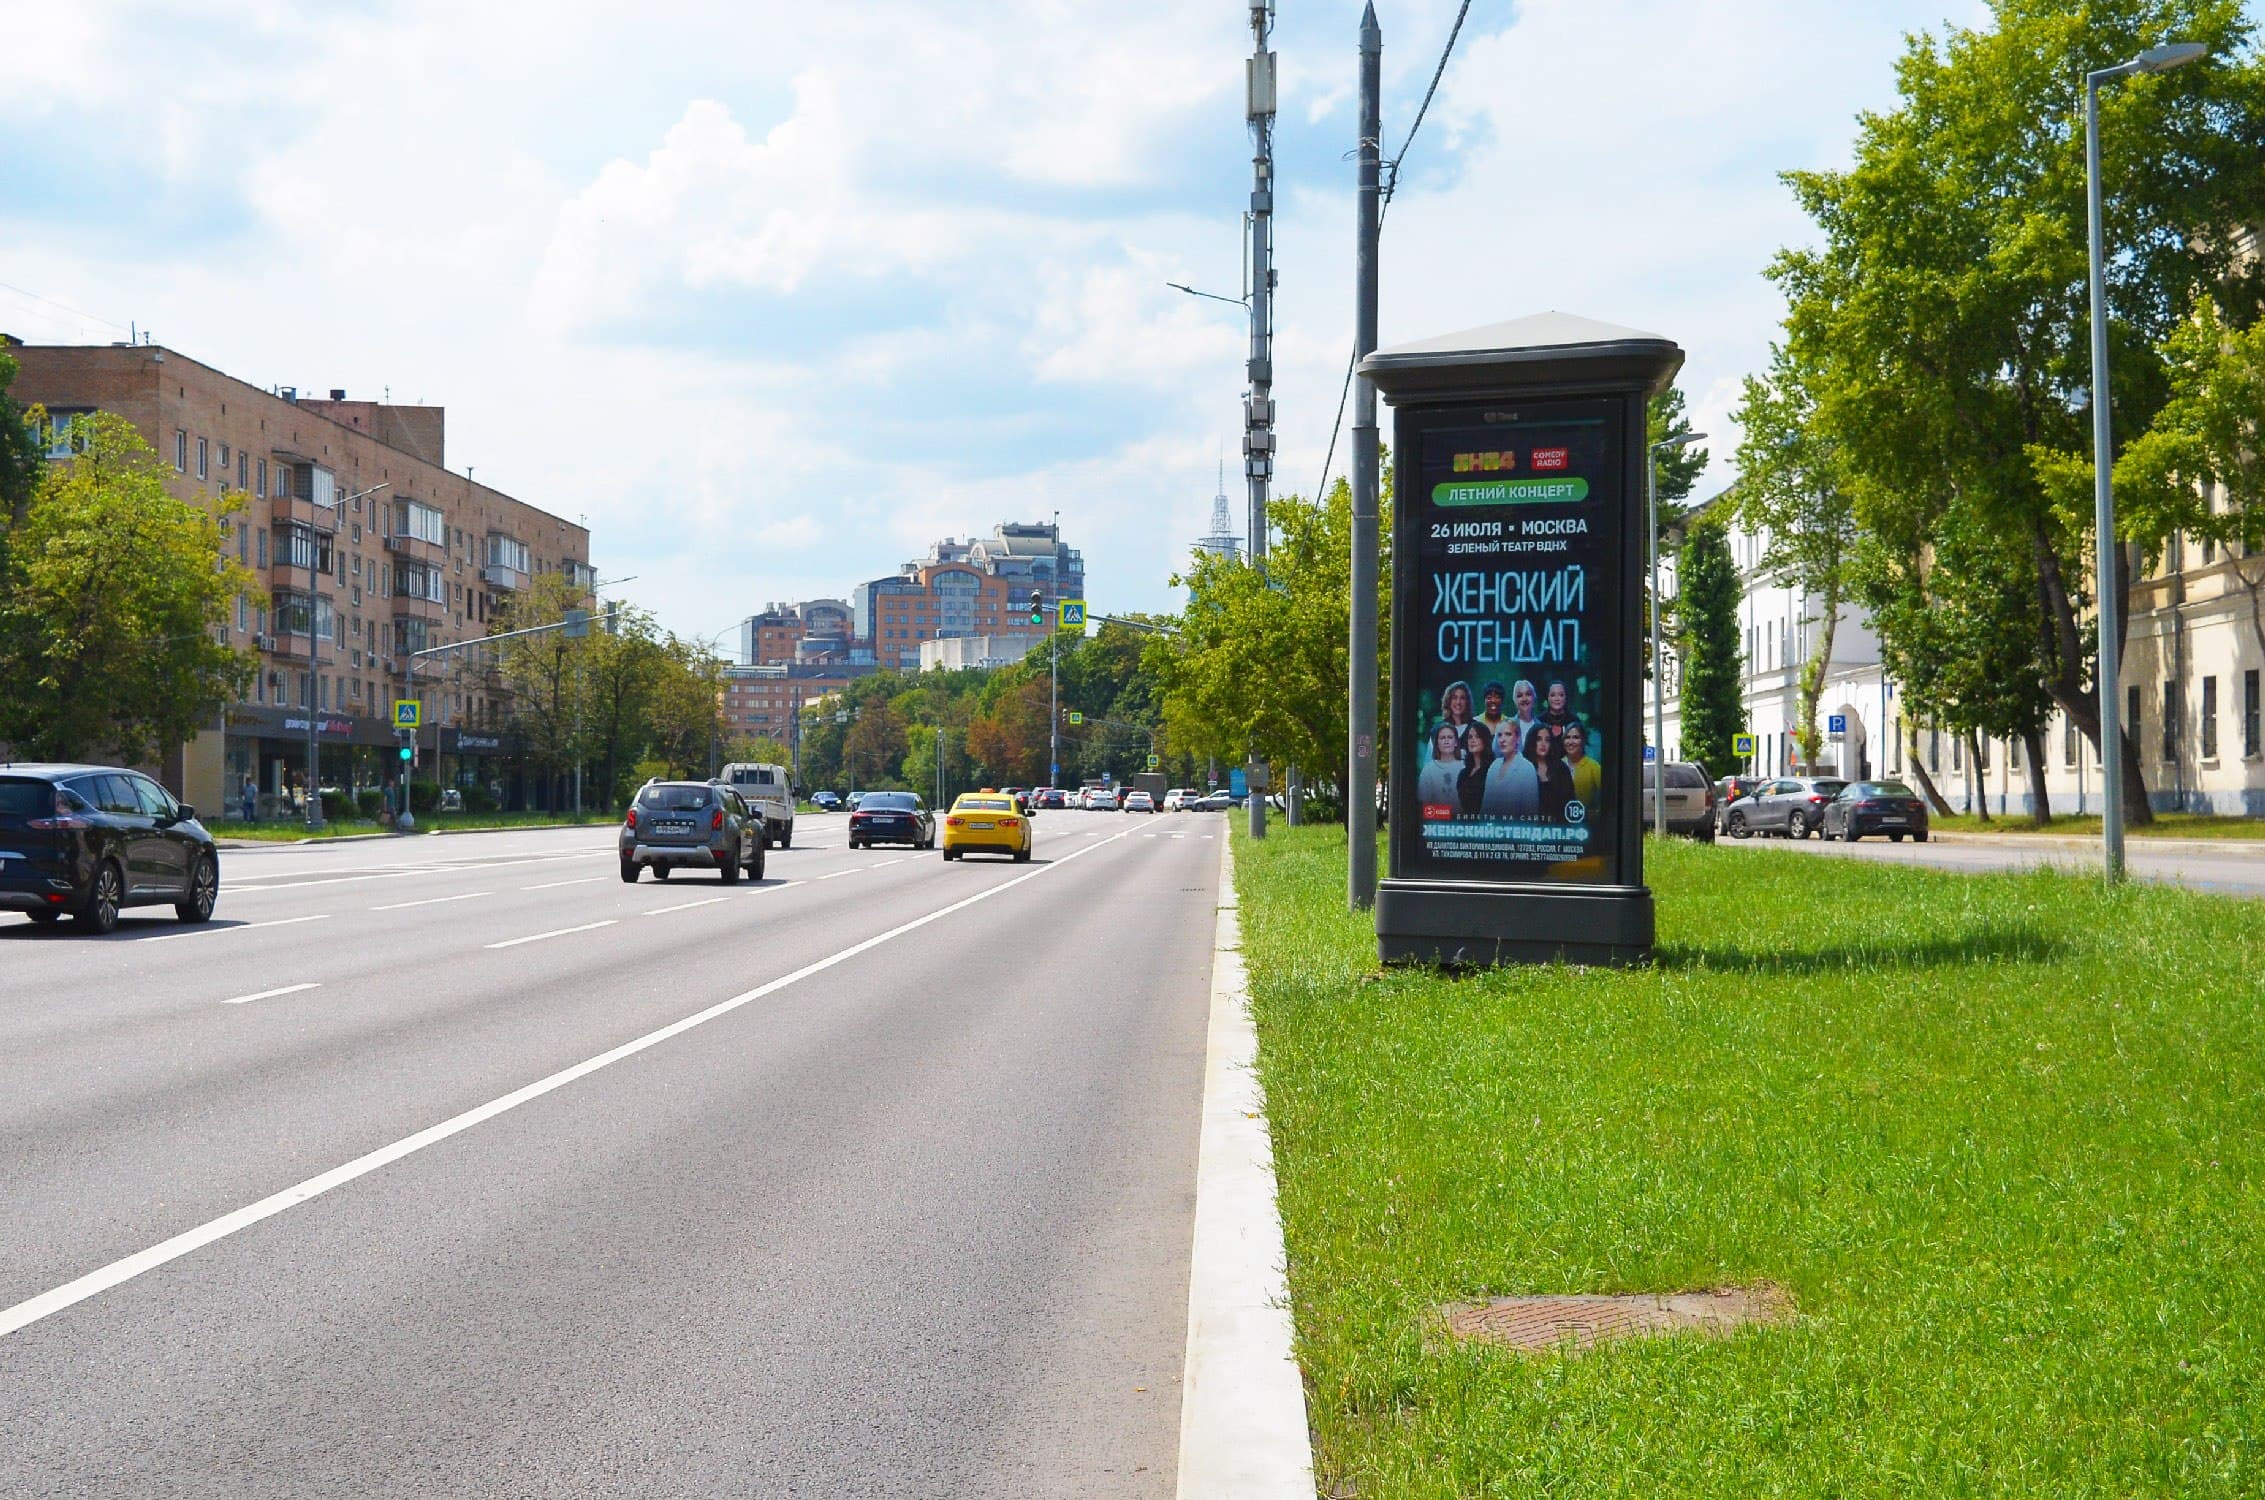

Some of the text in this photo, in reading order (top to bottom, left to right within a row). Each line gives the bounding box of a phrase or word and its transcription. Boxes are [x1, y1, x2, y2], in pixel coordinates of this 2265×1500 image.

[1533, 450, 1566, 459] COMEDY
[1536, 458, 1561, 467] RADIO
[1448, 484, 1574, 501] ЛЕТНИЙ КОНЦЕРТ
[1431, 518, 1588, 538] 26 ИЮЛЯ МОСКВА
[1447, 540, 1567, 554] ЗЕЛЕНЫЙ ТЕАТР ВДНХ
[1431, 564, 1585, 615] ЖЕНСКИЙ
[1437, 619, 1580, 663] СТЕНДАП
[1456, 813, 1496, 821] БИЛЕТЫ
[1568, 805, 1585, 818] 18+
[1422, 823, 1589, 842] ЖЕНСКИЙСТЕНДАП.РФ
